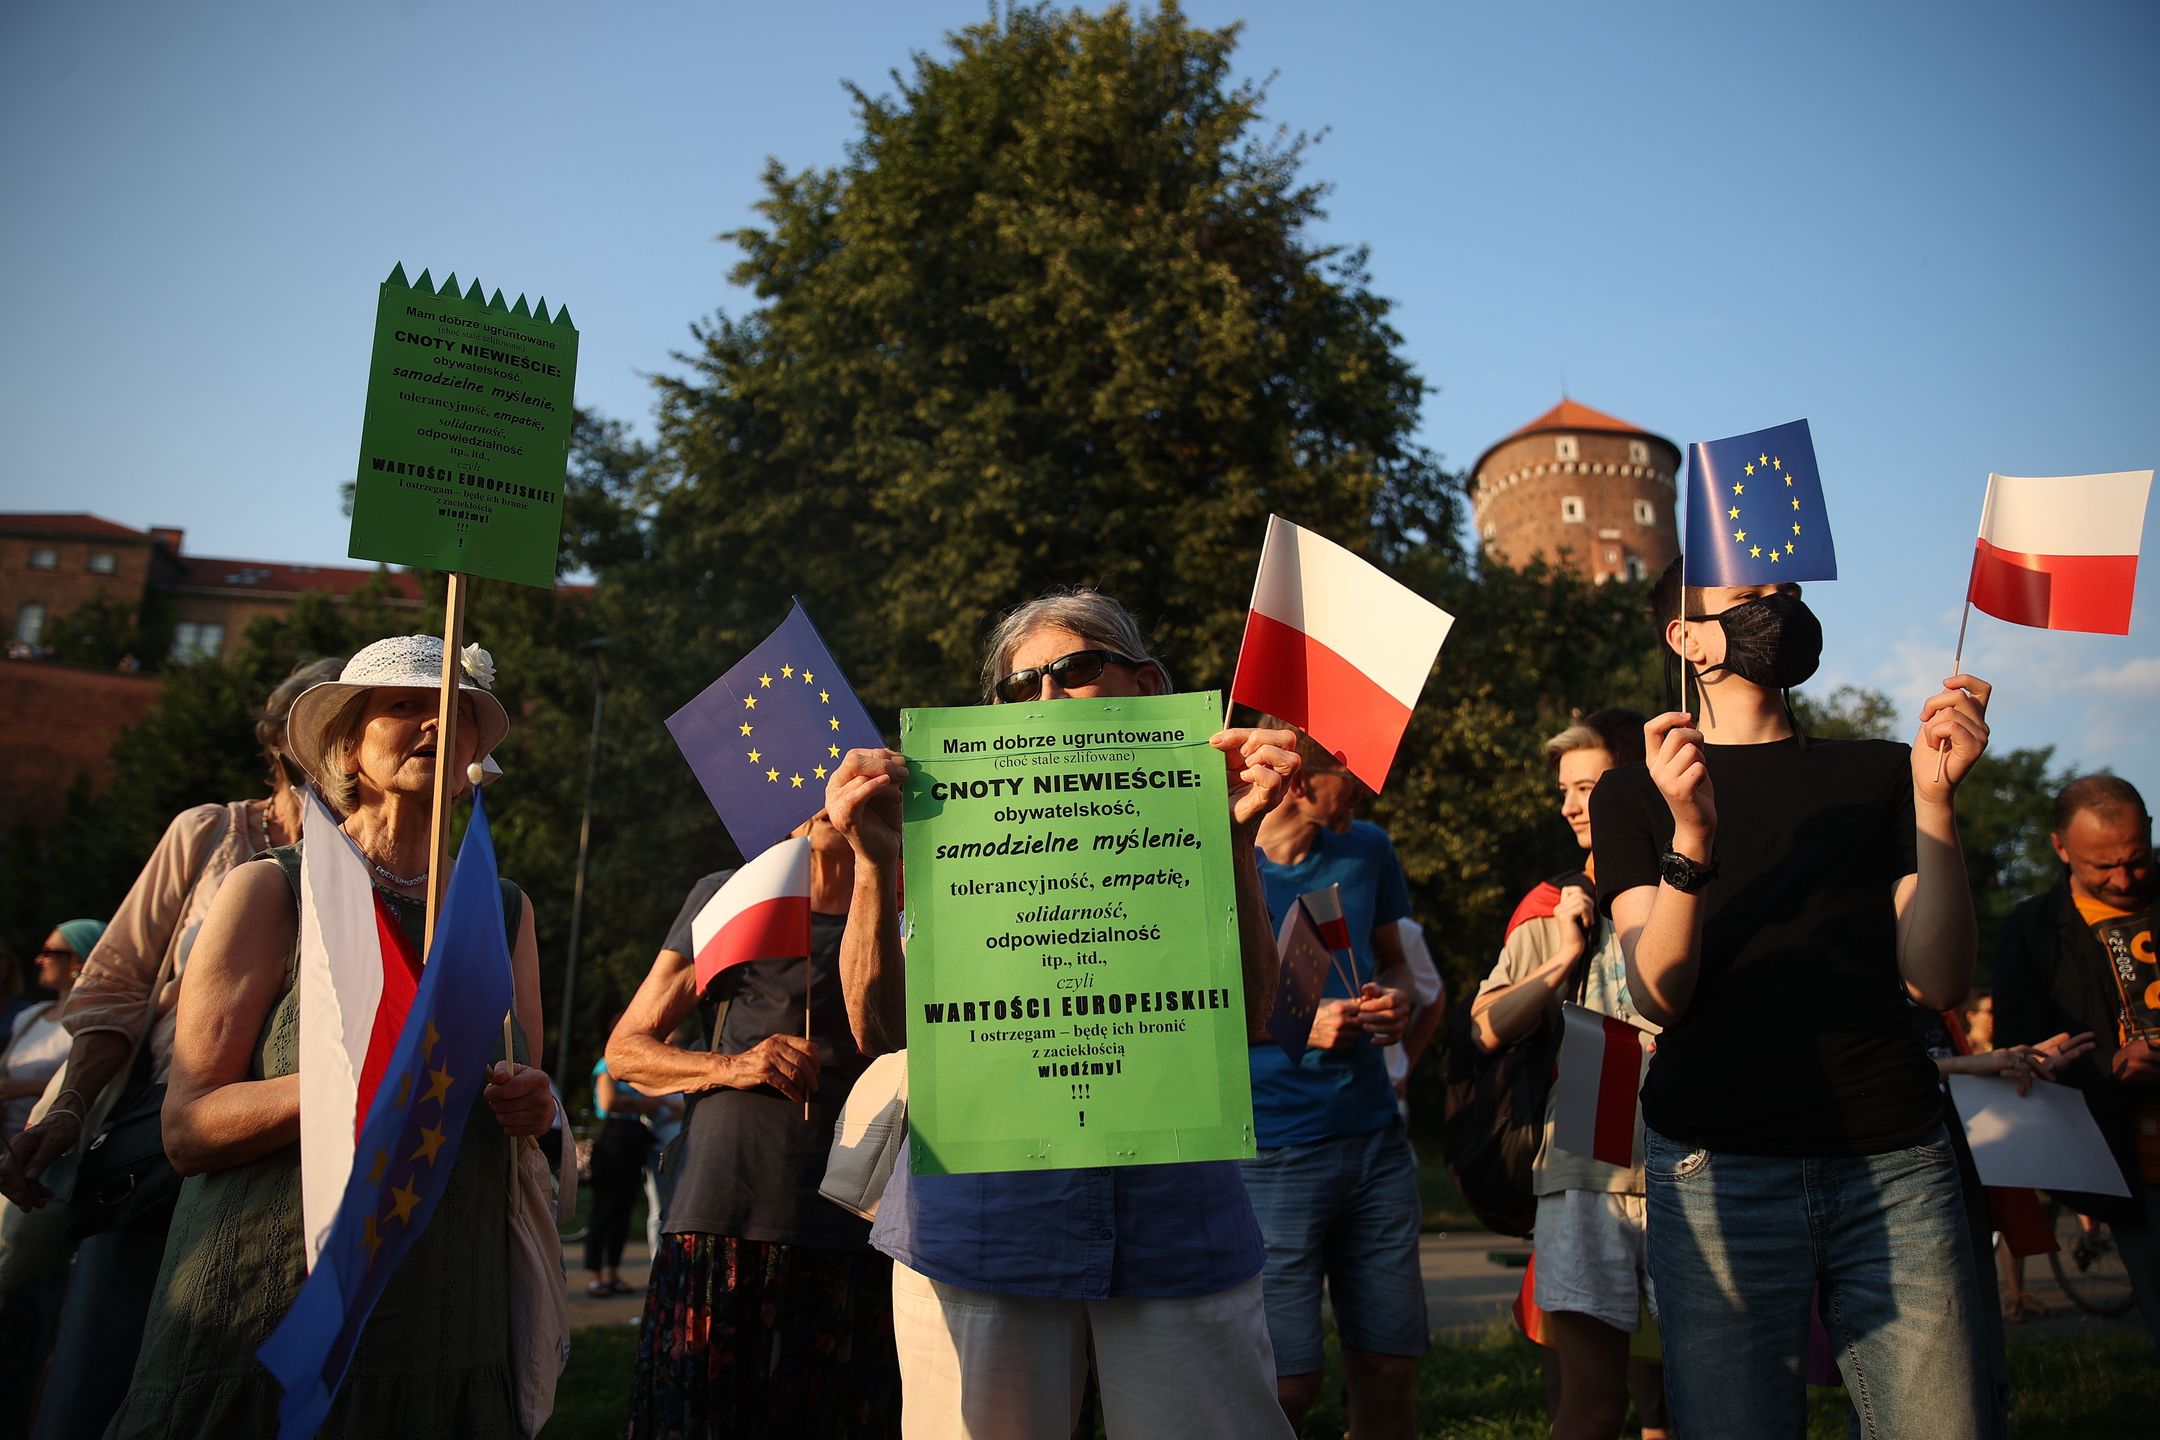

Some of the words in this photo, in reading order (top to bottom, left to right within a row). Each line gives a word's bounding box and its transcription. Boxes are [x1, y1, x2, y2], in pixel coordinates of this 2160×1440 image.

[406, 306, 435, 321] Mam
[438, 314, 480, 329] dobrze
[483, 323, 556, 350] ugruntowane
[394, 330, 456, 352] CNOTY
[460, 343, 561, 378] NIEWIEŚCIE:
[433, 355, 523, 385] obywatelskość,
[392, 367, 484, 393] samodzielne
[491, 387, 555, 412] myślenie,
[399, 391, 490, 417] tolerancyjność,
[493, 412, 545, 431] empatię,
[417, 427, 523, 456] odpowiedzialność
[439, 417, 506, 440] solidarność,
[372, 457, 452, 483] WARTOŚCI
[458, 472, 555, 504] EUROPEJSKIE!
[457, 461, 481, 473] czyli
[405, 482, 453, 495] ostrzegam
[463, 489, 485, 503] będę
[486, 495, 499, 504] ich
[501, 497, 529, 510] bronić
[943, 738, 987, 754] Mam
[993, 734, 1056, 751] dobrze
[1062, 728, 1185, 747] ugruntowane
[994, 754, 1028, 770] (choć
[1031, 753, 1060, 766] stale
[1063, 750, 1136, 764] szlifowane)
[930, 777, 1024, 801] CNOTY
[1033, 766, 1201, 794] NIEWIEŚCIE:
[994, 799, 1140, 825] obywatelskość,
[935, 831, 1079, 860] samodzielne
[1092, 826, 1202, 855] myślenie,
[950, 872, 1095, 897] tolerancyjność,
[1101, 869, 1190, 891] empatię,
[1015, 901, 1128, 924] solidarność,
[986, 924, 1161, 951] odpowiedzialność
[1042, 953, 1072, 970] itp.,
[1077, 951, 1108, 966] itd.,
[1056, 972, 1094, 992] czyli
[924, 996, 1051, 1024] WARTOŚCI
[1061, 988, 1230, 1017] EUROPEJSKIE!
[970, 1029, 975, 1043] I
[980, 1029, 1056, 1043] ostrzegam
[1073, 1023, 1108, 1040] będę
[1112, 1021, 1134, 1035] ich
[1138, 1018, 1186, 1034] bronić
[1032, 1049, 1039, 1058] z
[1043, 1042, 1125, 1058] zaciekłością
[1071, 1083, 1090, 1100] !!!
[1079, 1111, 1085, 1127] !
